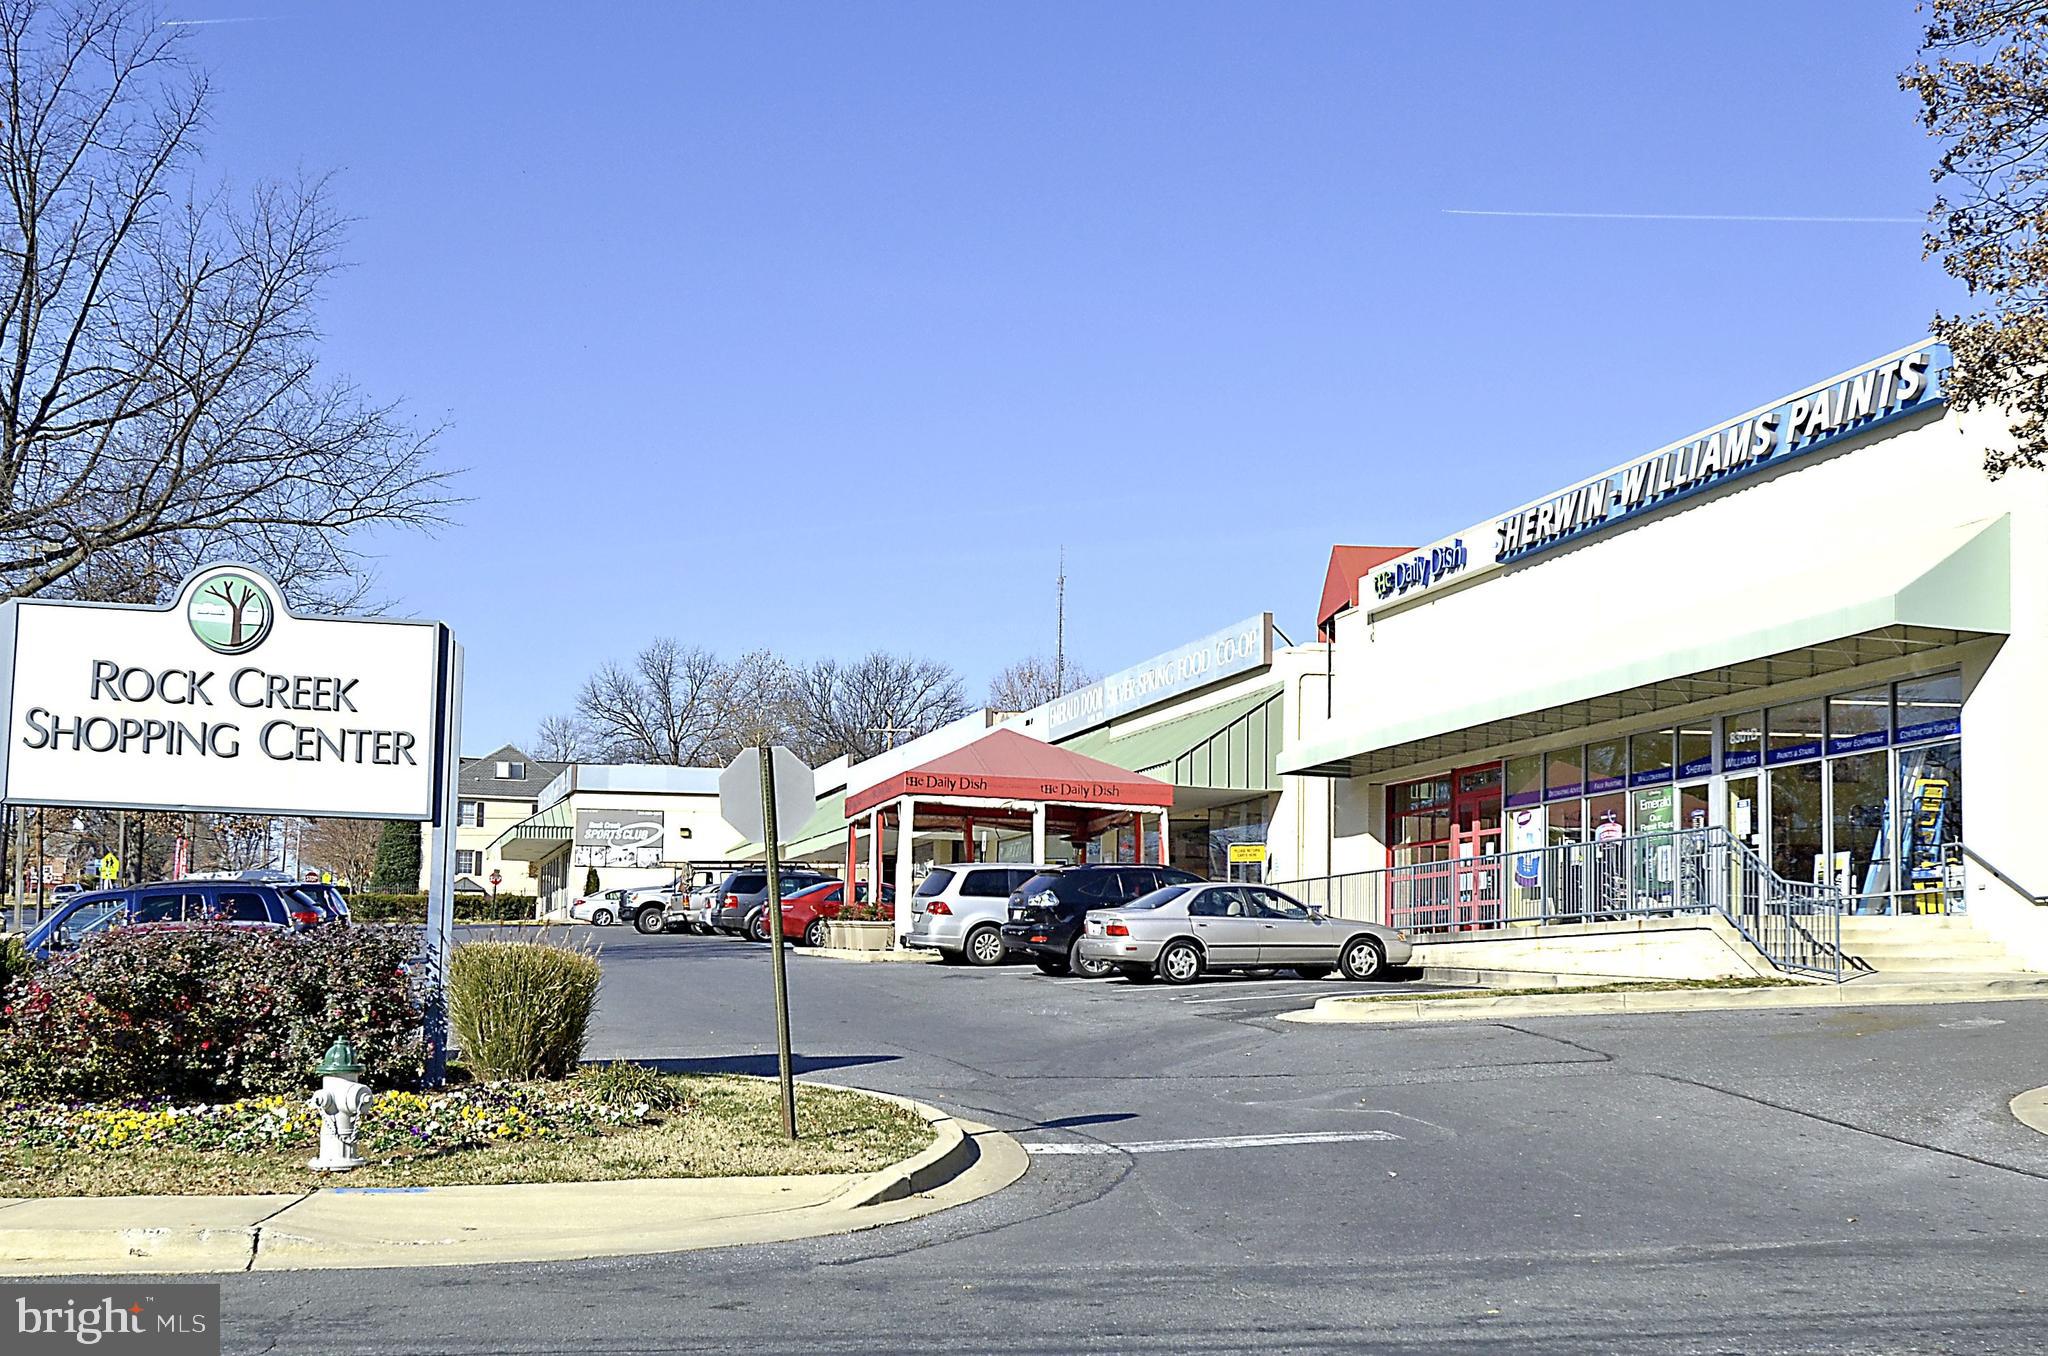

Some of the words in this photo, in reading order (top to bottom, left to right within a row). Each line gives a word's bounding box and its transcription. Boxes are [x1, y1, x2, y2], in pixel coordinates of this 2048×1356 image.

[1495, 413, 1780, 553] SHERWIN-WILLIAMS
[1787, 353, 1929, 443] PAINTS
[1394, 556, 1430, 593] Daily
[1430, 539, 1467, 581] Dish
[90, 659, 215, 706] ROCK
[229, 667, 360, 713] CREEK
[1107, 677, 1136, 706] SILVER
[1138, 660, 1174, 696] SPRING
[1177, 648, 1211, 681] FOOD
[1216, 630, 1257, 666] CO-OP
[23, 707, 240, 758] SHOPPING
[259, 719, 417, 766] CENTER
[1725, 755, 1757, 768] WILLIAMS
[926, 776, 956, 791] Daily
[960, 778, 987, 790] Dish
[1061, 783, 1090, 799] Daily
[1093, 784, 1120, 797] Dish
[1640, 795, 1672, 811] Emerald
